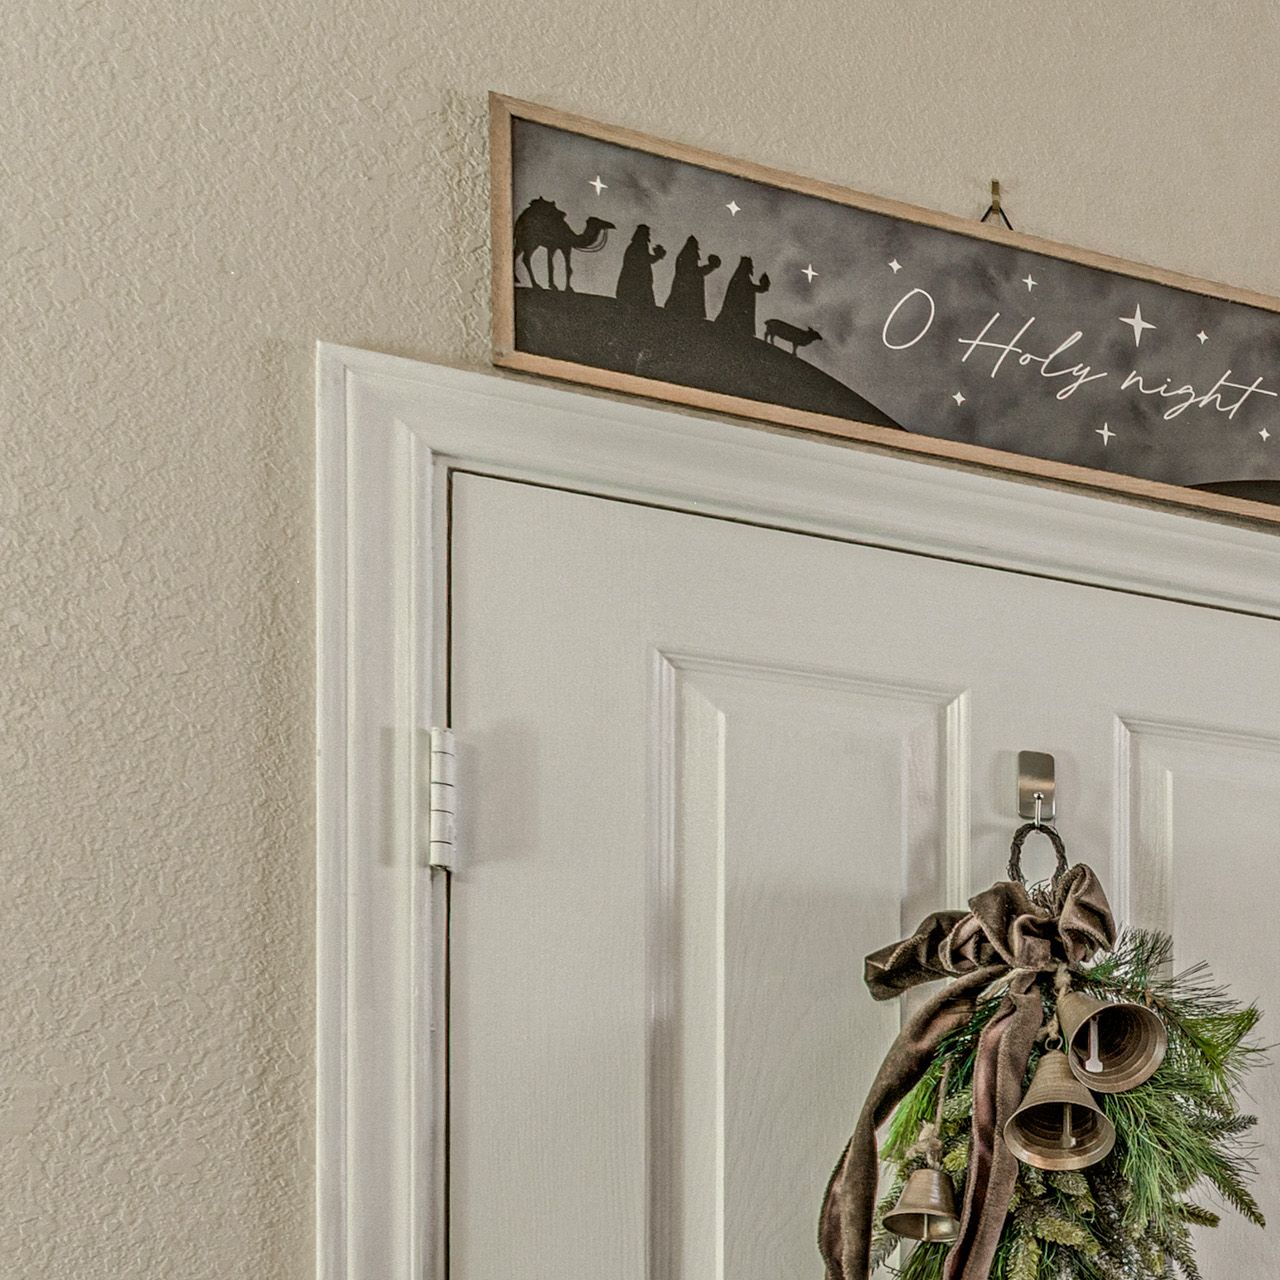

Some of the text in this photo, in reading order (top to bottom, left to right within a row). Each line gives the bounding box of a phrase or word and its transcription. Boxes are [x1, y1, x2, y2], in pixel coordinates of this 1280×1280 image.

[882, 288, 1278, 420] O Holy night
